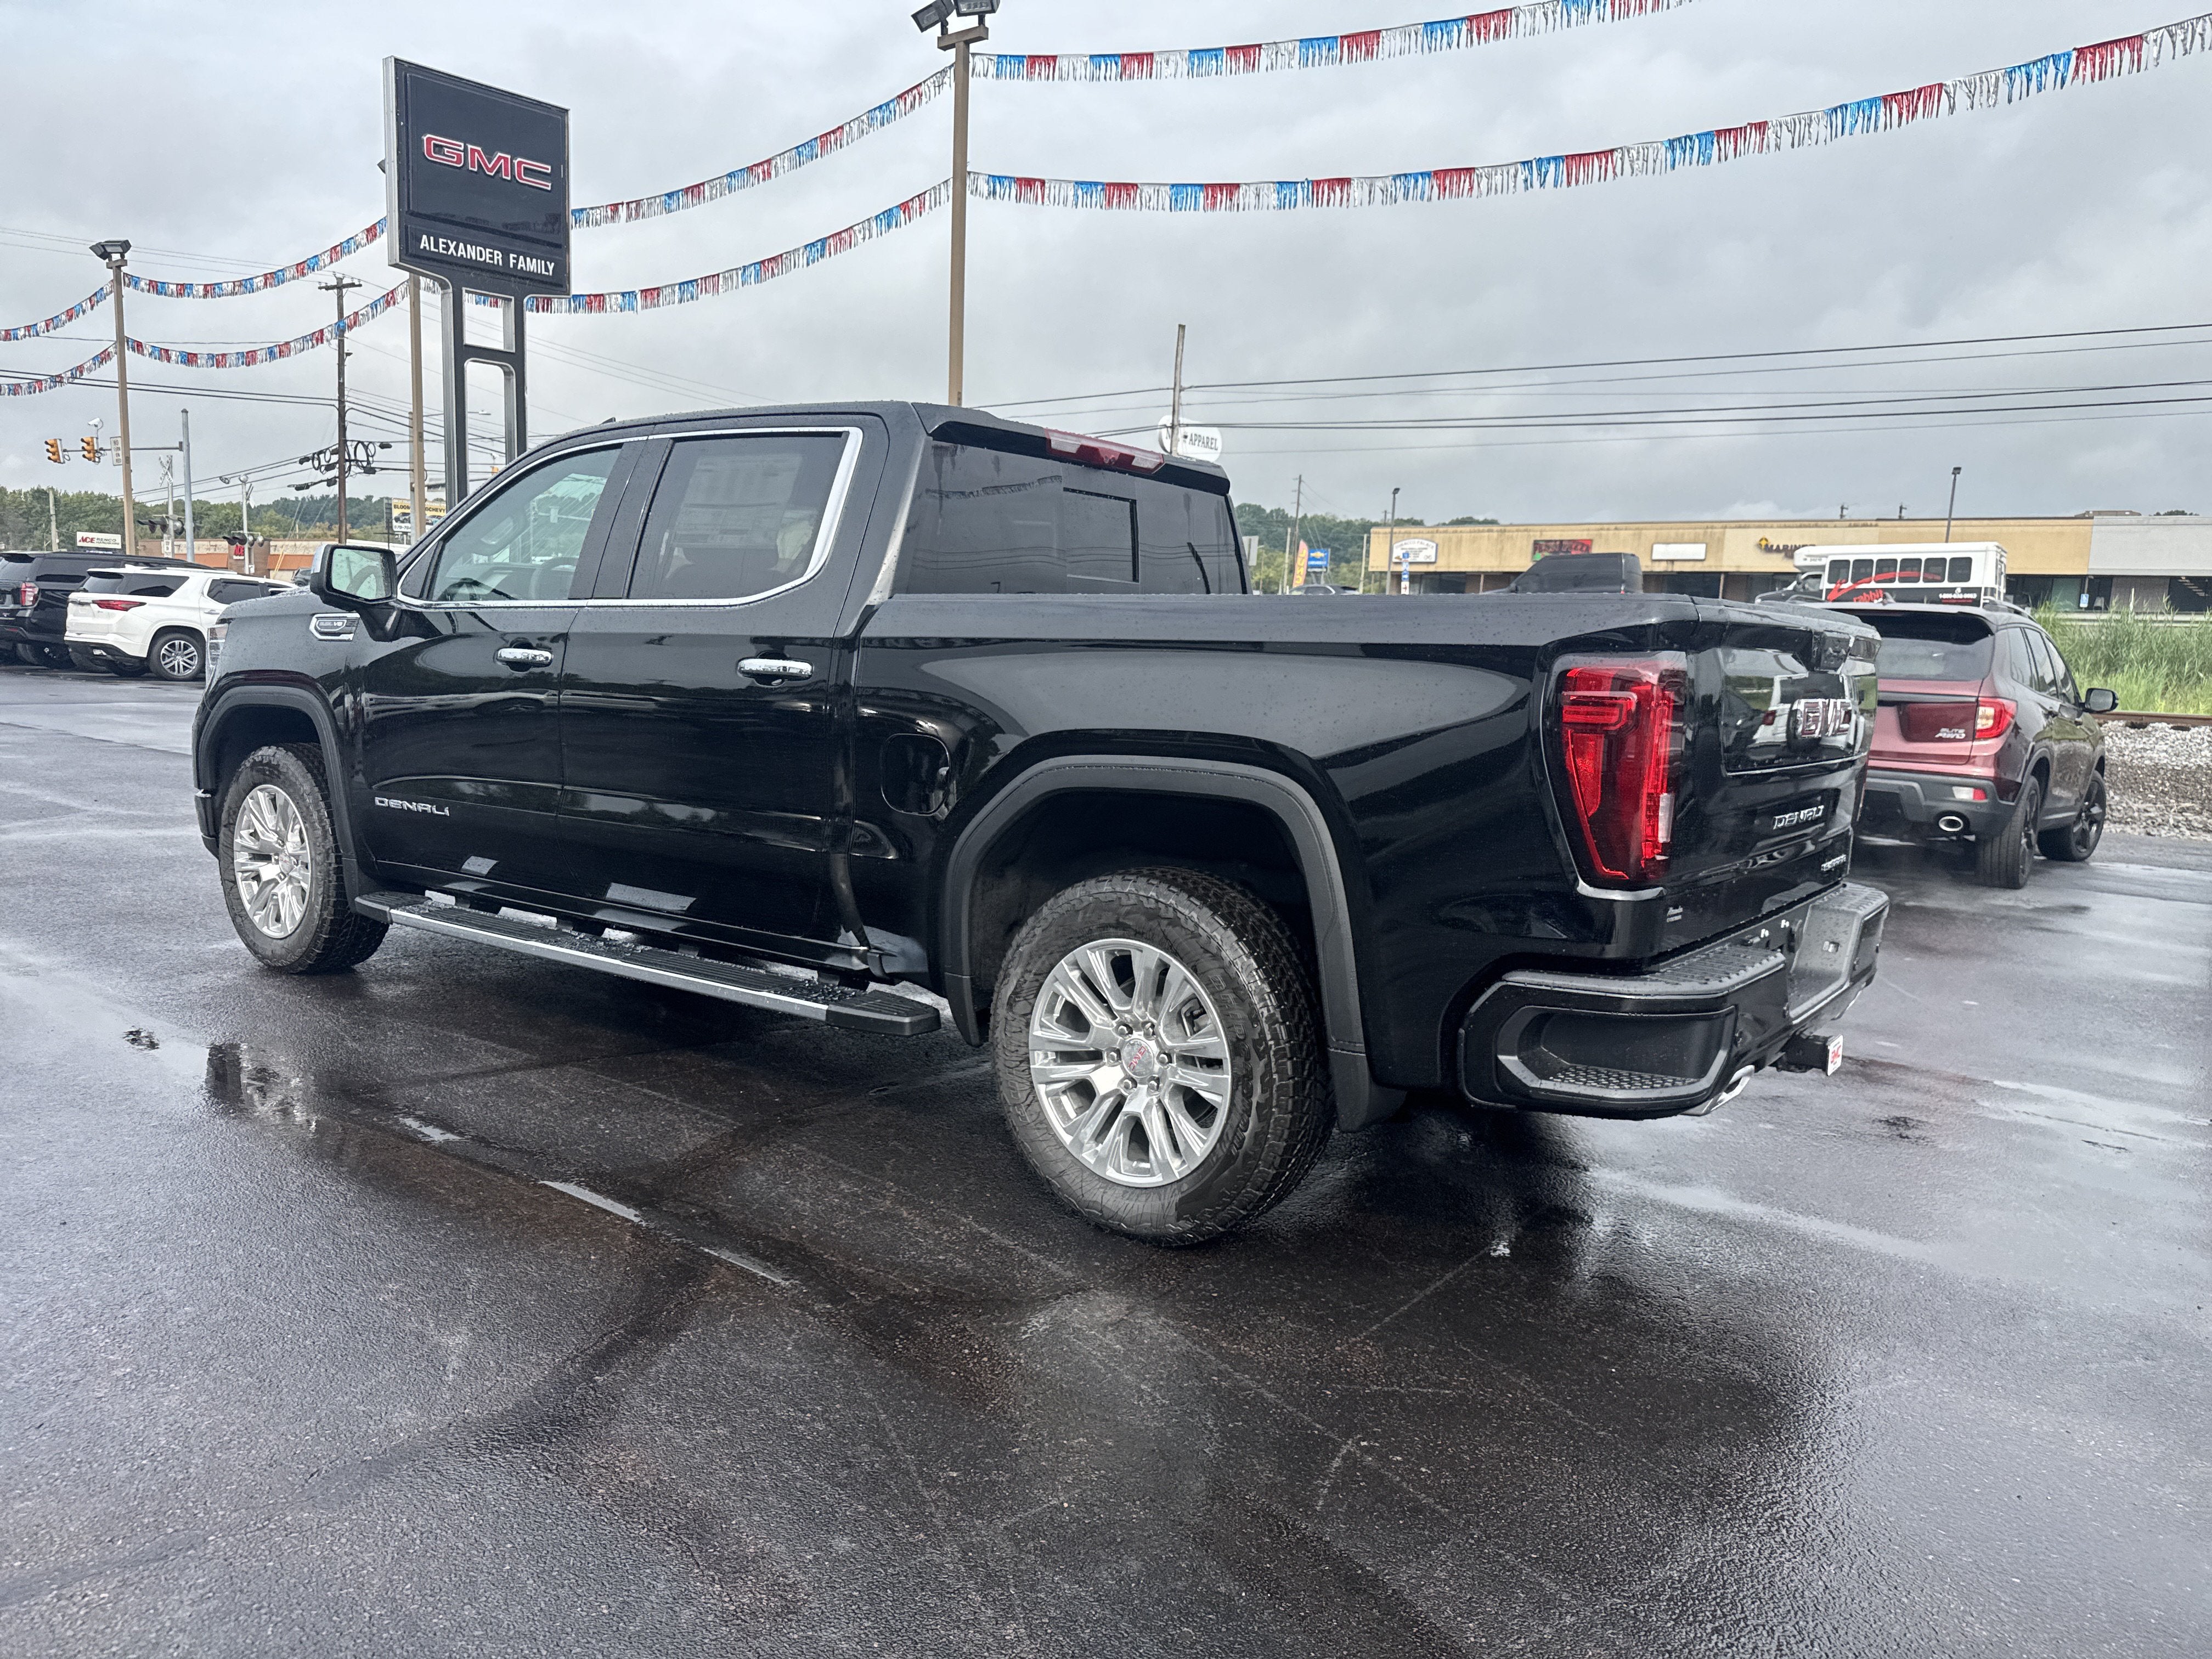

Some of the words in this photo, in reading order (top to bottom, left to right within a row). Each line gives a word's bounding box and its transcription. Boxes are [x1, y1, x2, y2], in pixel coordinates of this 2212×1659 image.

[423, 134, 551, 190] GMC
[420, 234, 503, 266] ALEXANDER
[510, 253, 555, 276] FAMILY
[1188, 433, 1218, 451] APPAREL
[371, 797, 450, 817] DENALI
[1128, 1046, 1147, 1071] GMC
